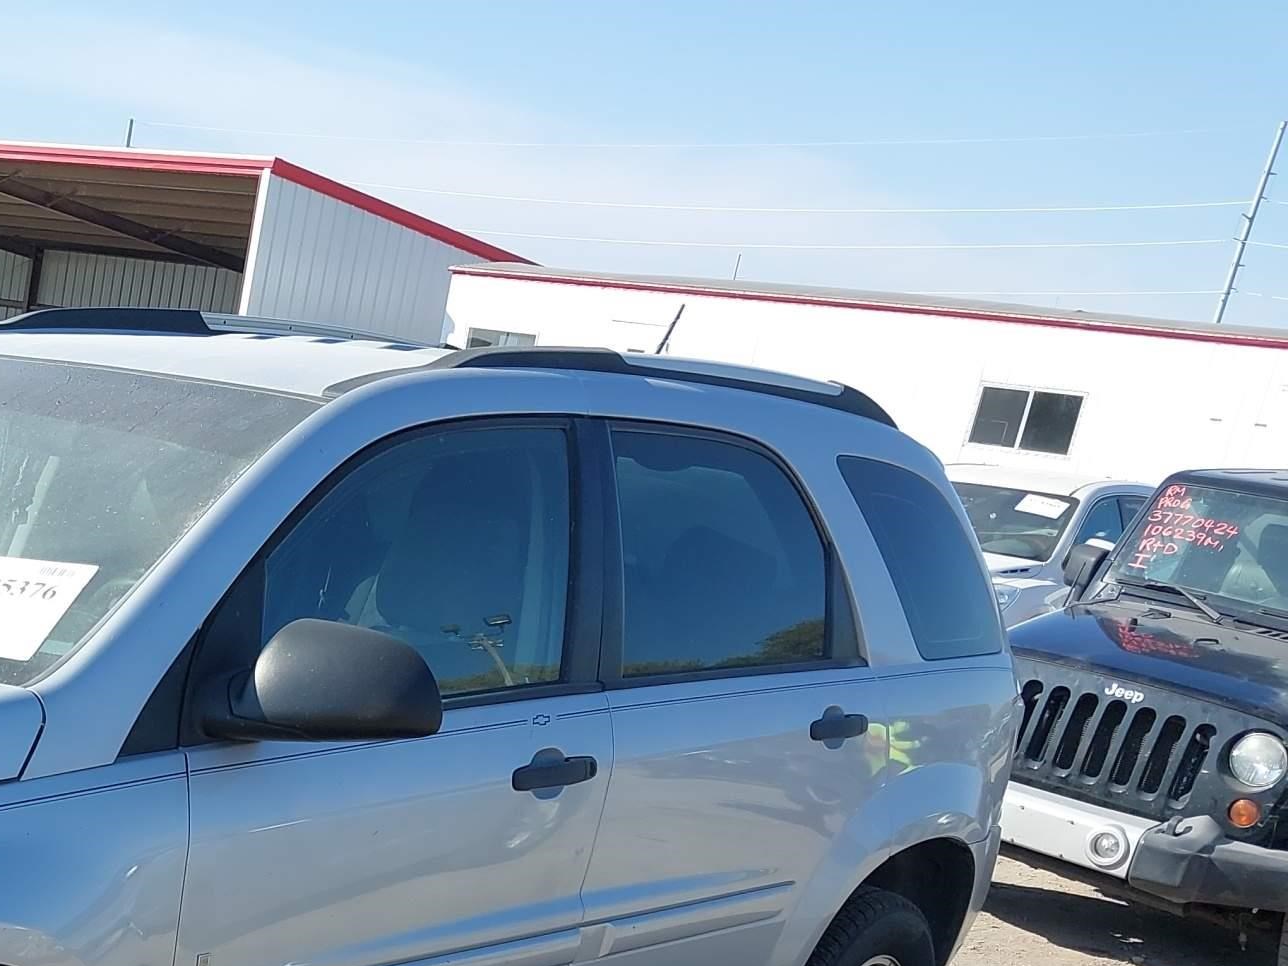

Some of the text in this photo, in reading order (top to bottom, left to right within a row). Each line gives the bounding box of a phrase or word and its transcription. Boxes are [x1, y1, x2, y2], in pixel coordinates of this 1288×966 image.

[1166, 485, 1186, 497] RM
[1158, 496, 1192, 511] PROG
[1147, 510, 1238, 539] 37770424
[1104, 682, 1145, 704] Jeep
